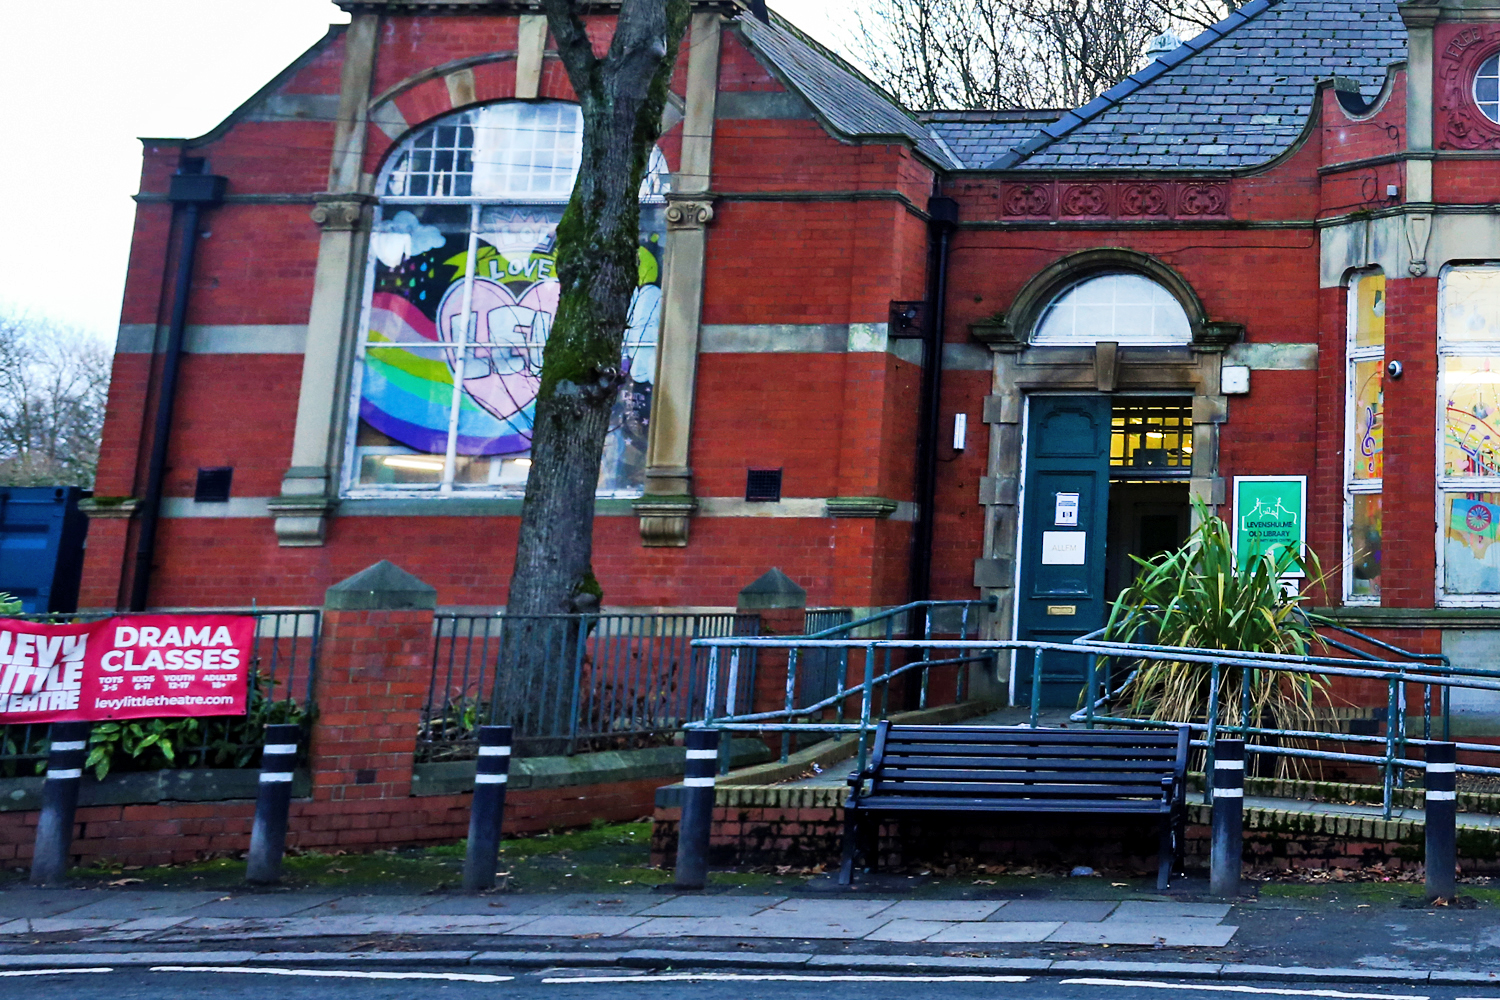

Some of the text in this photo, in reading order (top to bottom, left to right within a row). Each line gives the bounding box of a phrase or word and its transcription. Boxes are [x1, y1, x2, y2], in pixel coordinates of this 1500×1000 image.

[1446, 27, 1481, 57] FREE
[488, 257, 554, 281] LOVE
[114, 626, 233, 648] DRAMA
[0, 630, 90, 668] LEVY
[100, 649, 240, 672] CLASSES
[0, 661, 84, 693] ITTLE
[98, 673, 238, 684] TOTS KIDS YOUTH ADULTS
[102, 681, 227, 692] 3-5 6-11 12-17 18+
[94, 694, 234, 711] levylittletheatre.com
